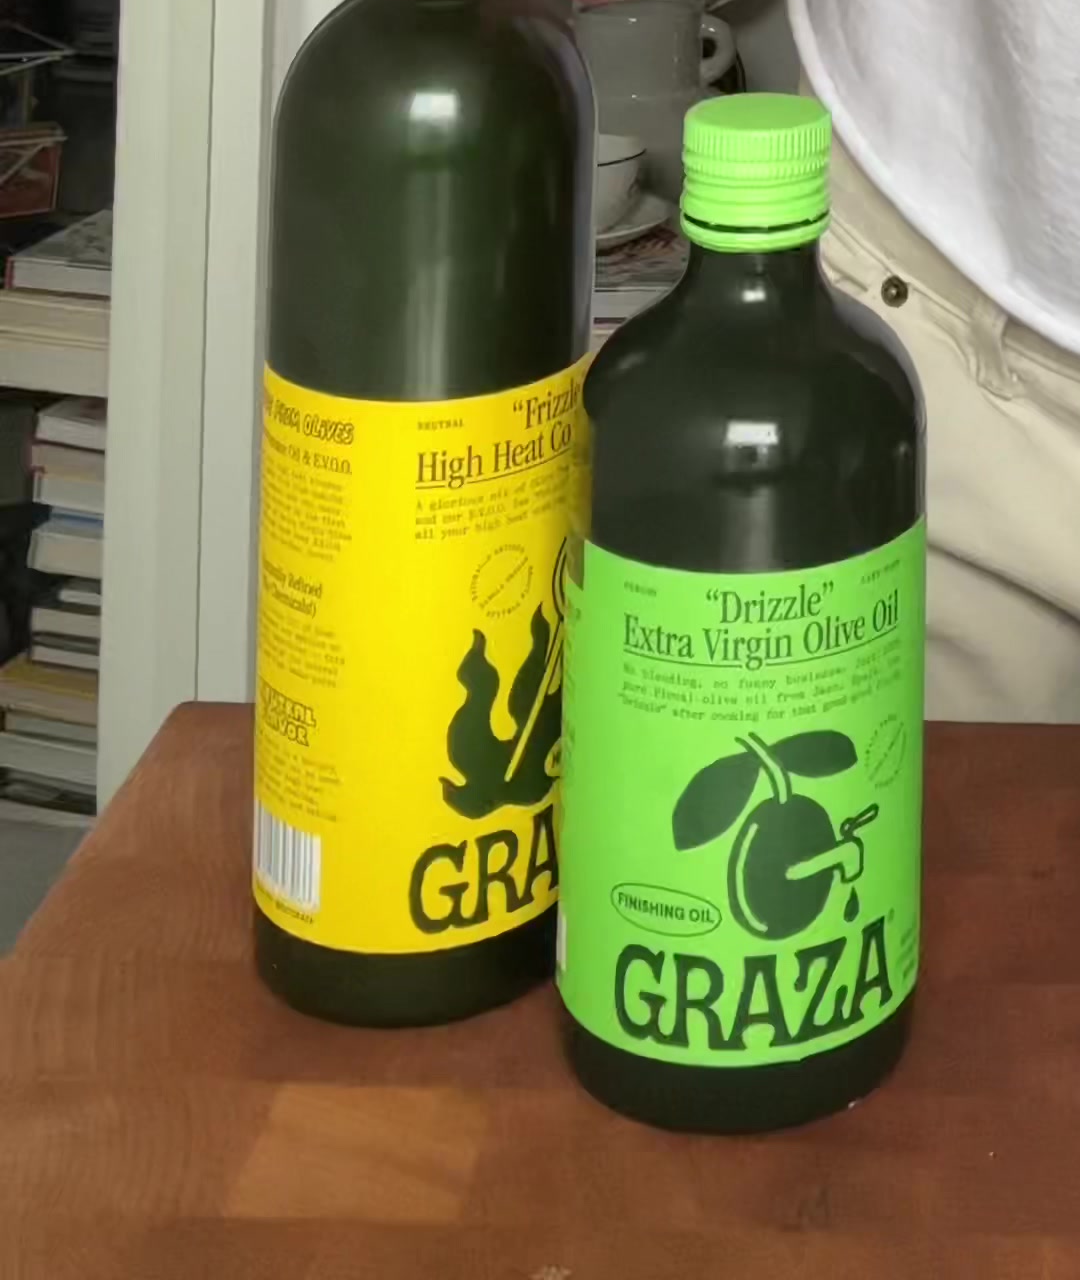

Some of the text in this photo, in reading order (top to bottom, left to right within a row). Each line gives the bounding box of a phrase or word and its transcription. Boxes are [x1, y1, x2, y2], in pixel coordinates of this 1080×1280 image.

[416, 444, 484, 490] High
[493, 431, 545, 473] Heat
[623, 612, 695, 659] Extra
[703, 628, 793, 671] Virgin
[802, 615, 867, 654] Olive
[872, 588, 899, 633] Oil
[706, 580, 835, 624] “Drizzle”
[408, 803, 560, 935] GRA
[617, 891, 715, 924] FINISHING OIL
[614, 915, 893, 1051] GRAZA
